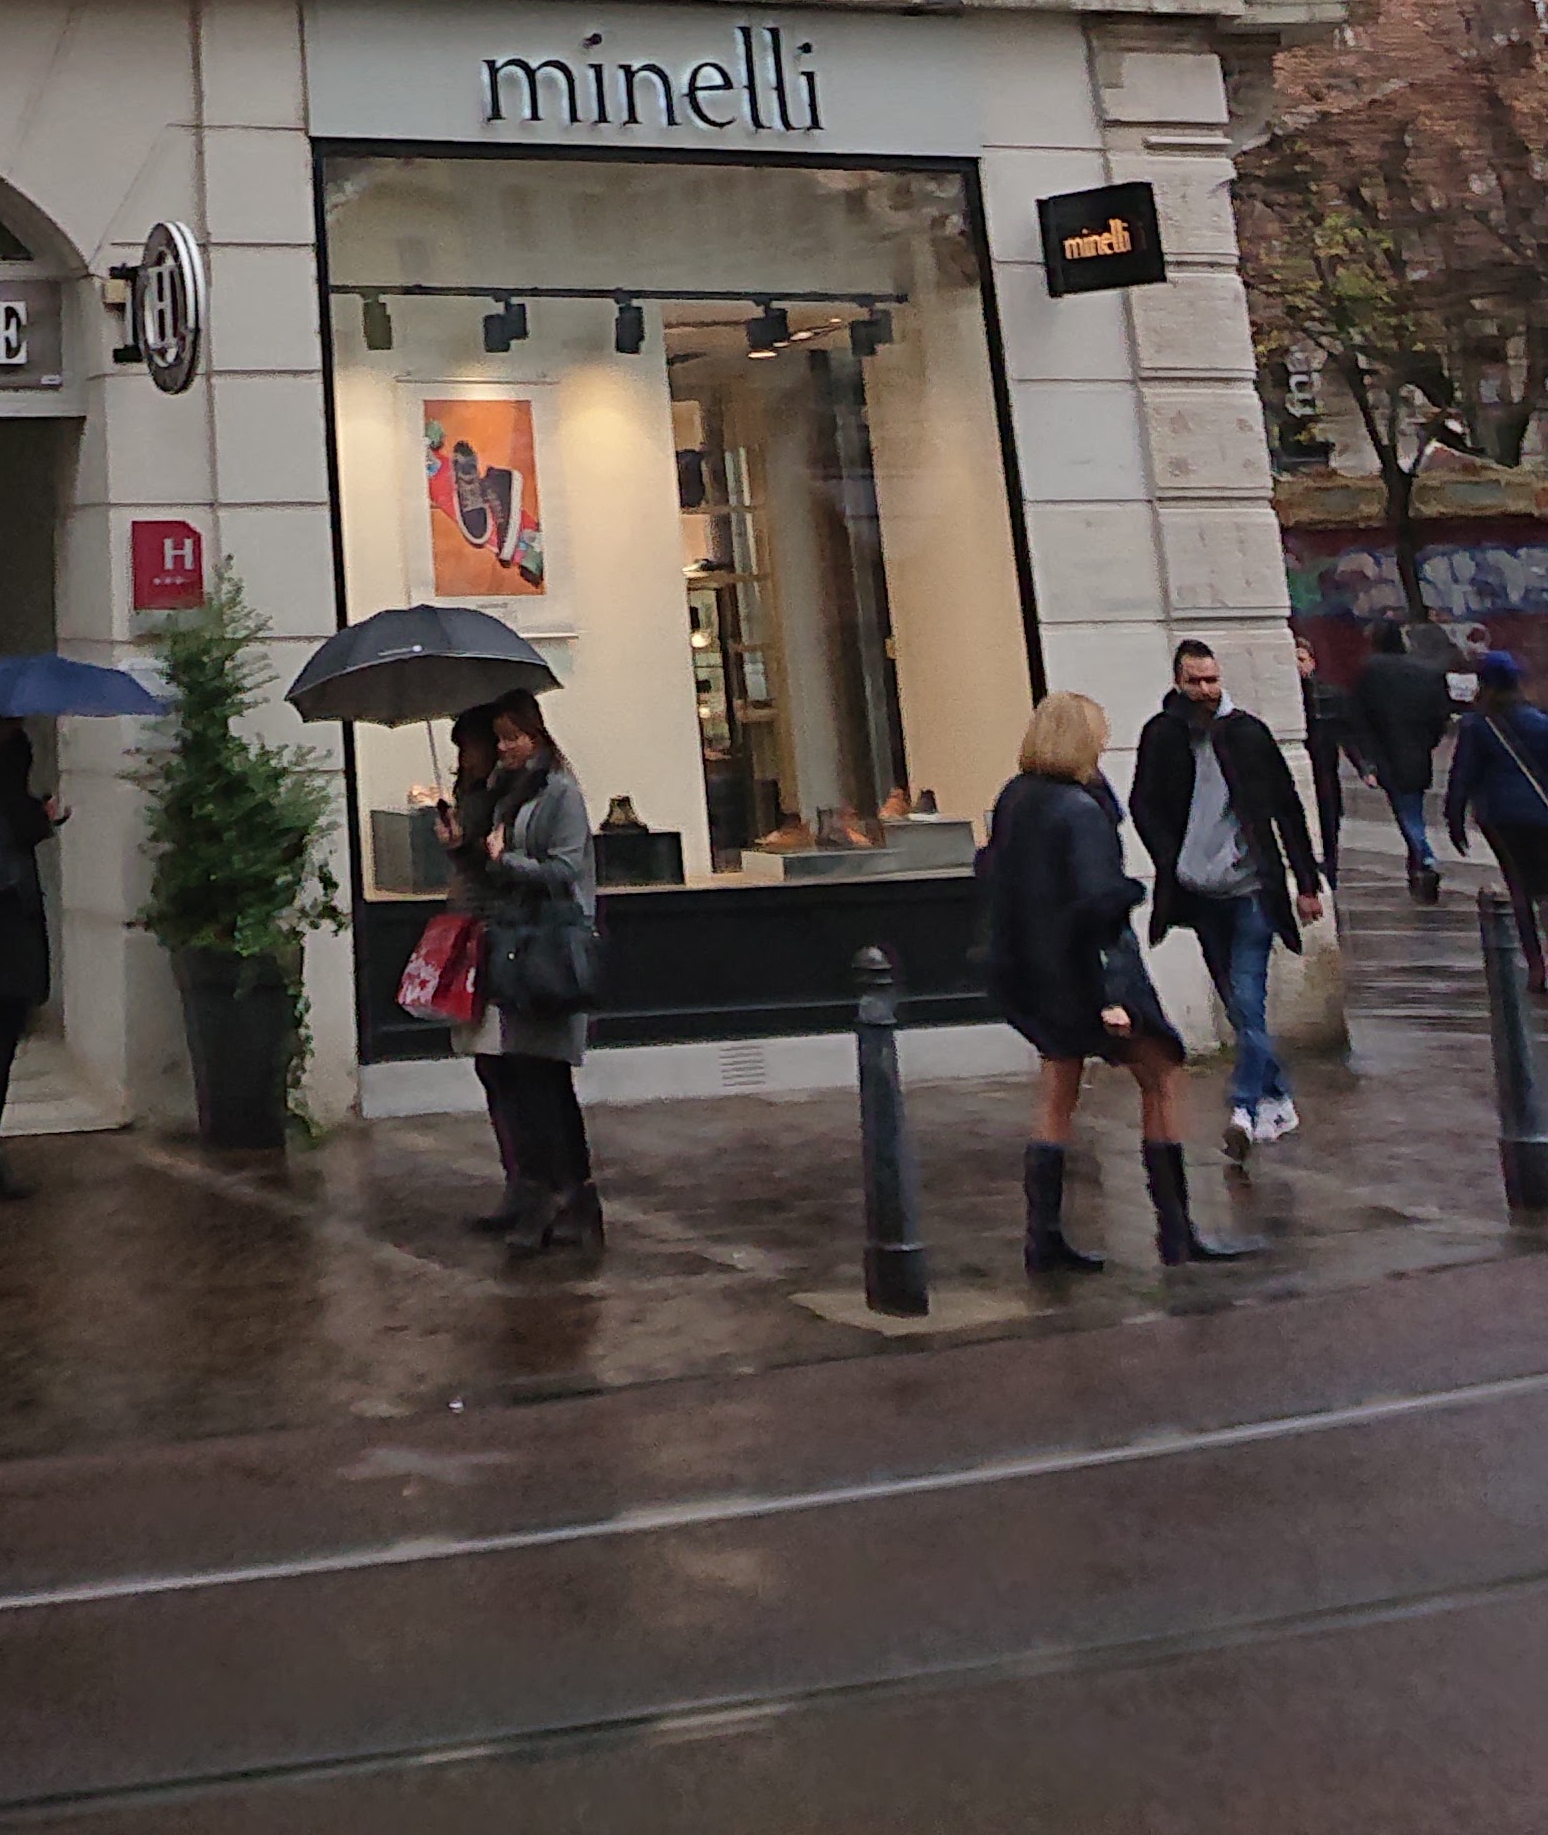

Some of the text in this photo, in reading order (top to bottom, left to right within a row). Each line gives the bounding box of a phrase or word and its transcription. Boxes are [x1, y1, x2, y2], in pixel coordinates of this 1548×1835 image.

[481, 25, 825, 132] minelli
[1063, 217, 1133, 260] minelli
[163, 537, 195, 572] H
